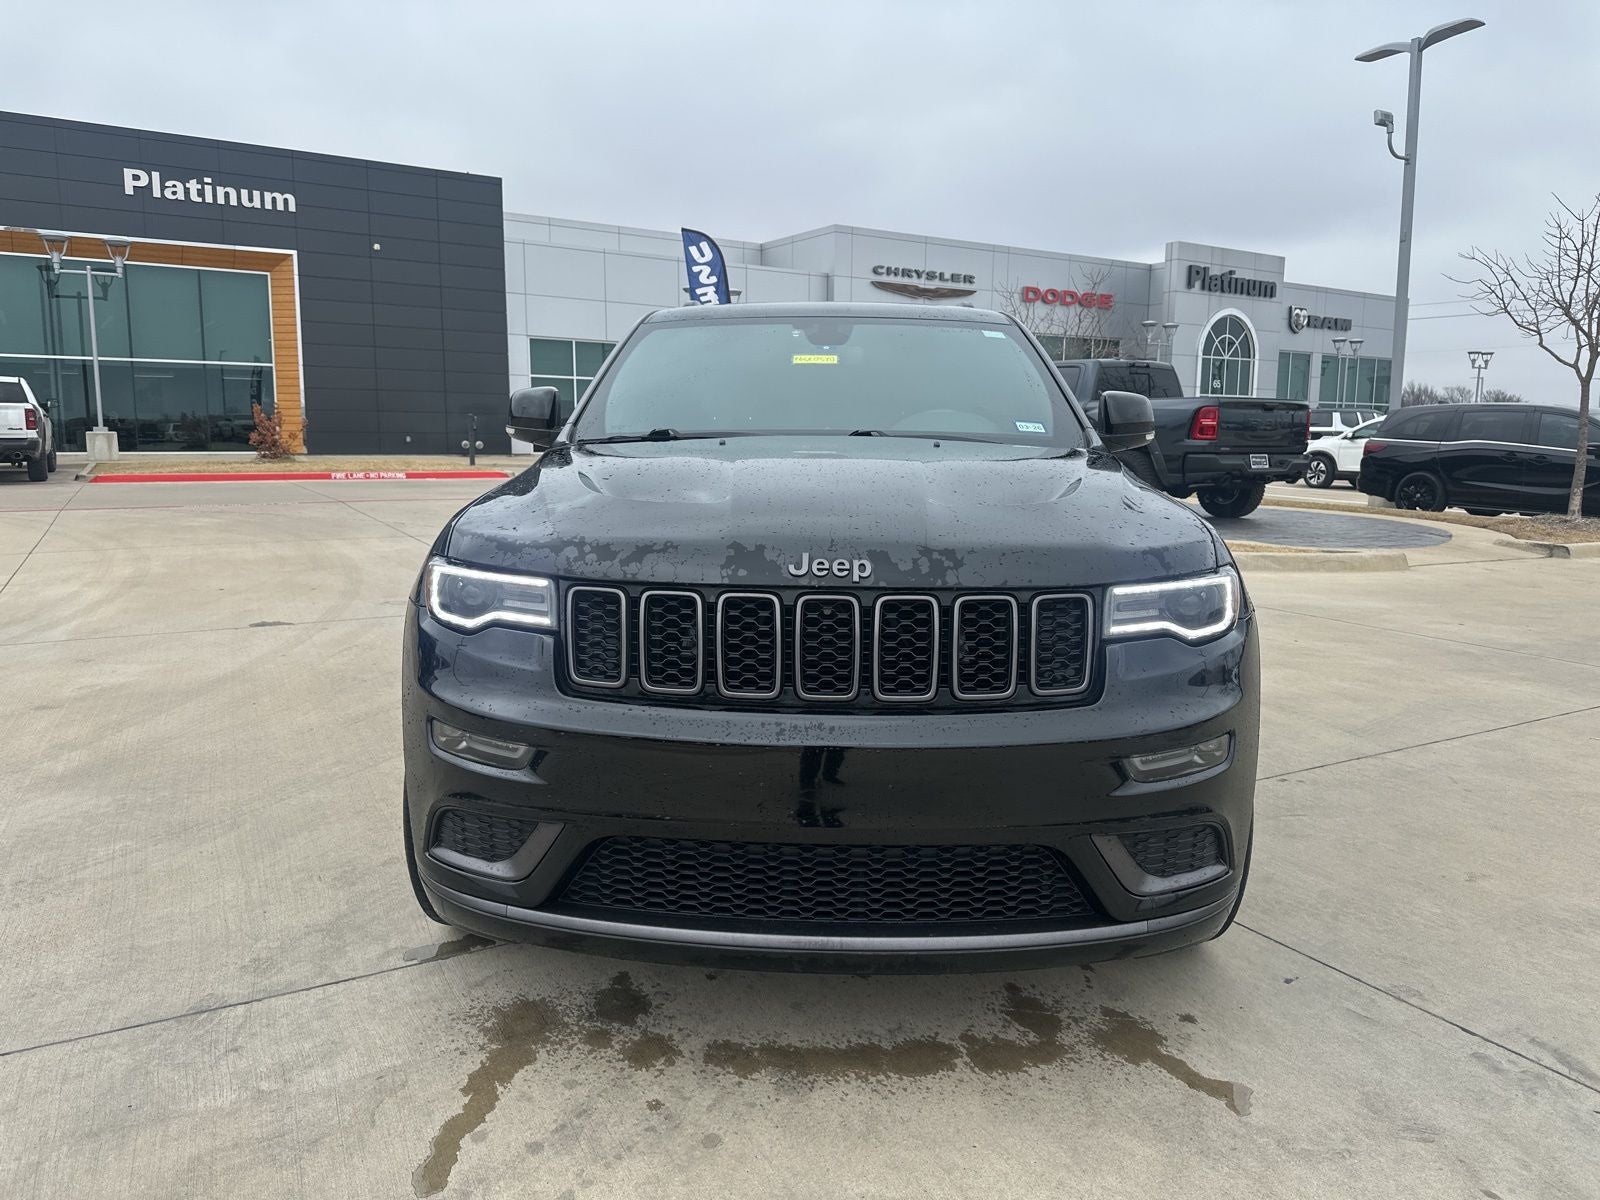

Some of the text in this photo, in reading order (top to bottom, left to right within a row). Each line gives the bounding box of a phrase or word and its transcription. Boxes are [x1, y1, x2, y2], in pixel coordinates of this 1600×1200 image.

[123, 167, 297, 213] Platinum
[872, 265, 976, 284] CHRYSLER
[1187, 264, 1277, 298] Platinum
[1023, 286, 1114, 311] DODGE
[1307, 315, 1352, 332] RAM
[788, 552, 872, 583] Jeep
